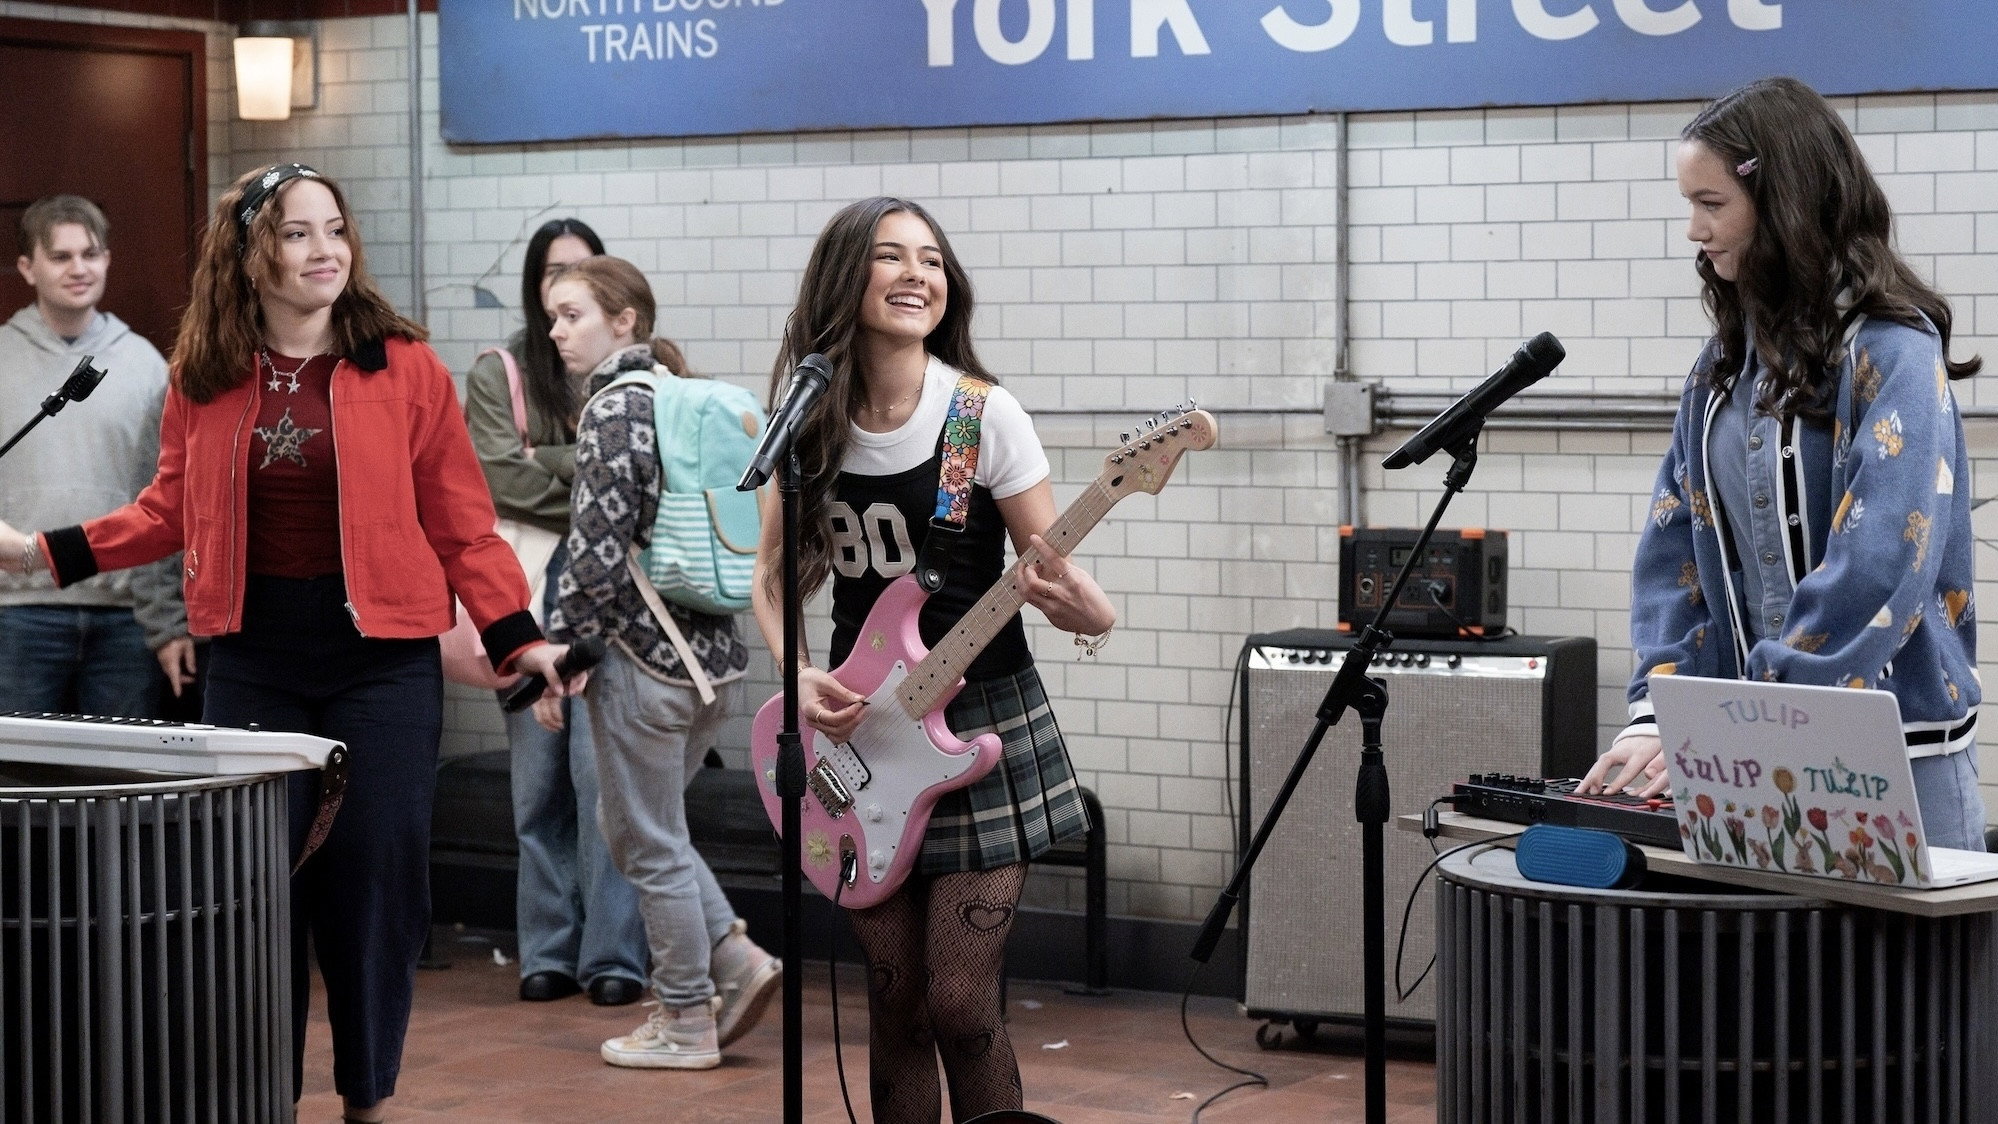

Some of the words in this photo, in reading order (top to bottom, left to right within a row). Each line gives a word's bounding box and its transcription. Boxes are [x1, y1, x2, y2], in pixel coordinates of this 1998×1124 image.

[580, 18, 718, 63] TRAINS
[823, 501, 916, 578] 80
[1718, 699, 1809, 729] TULIP
